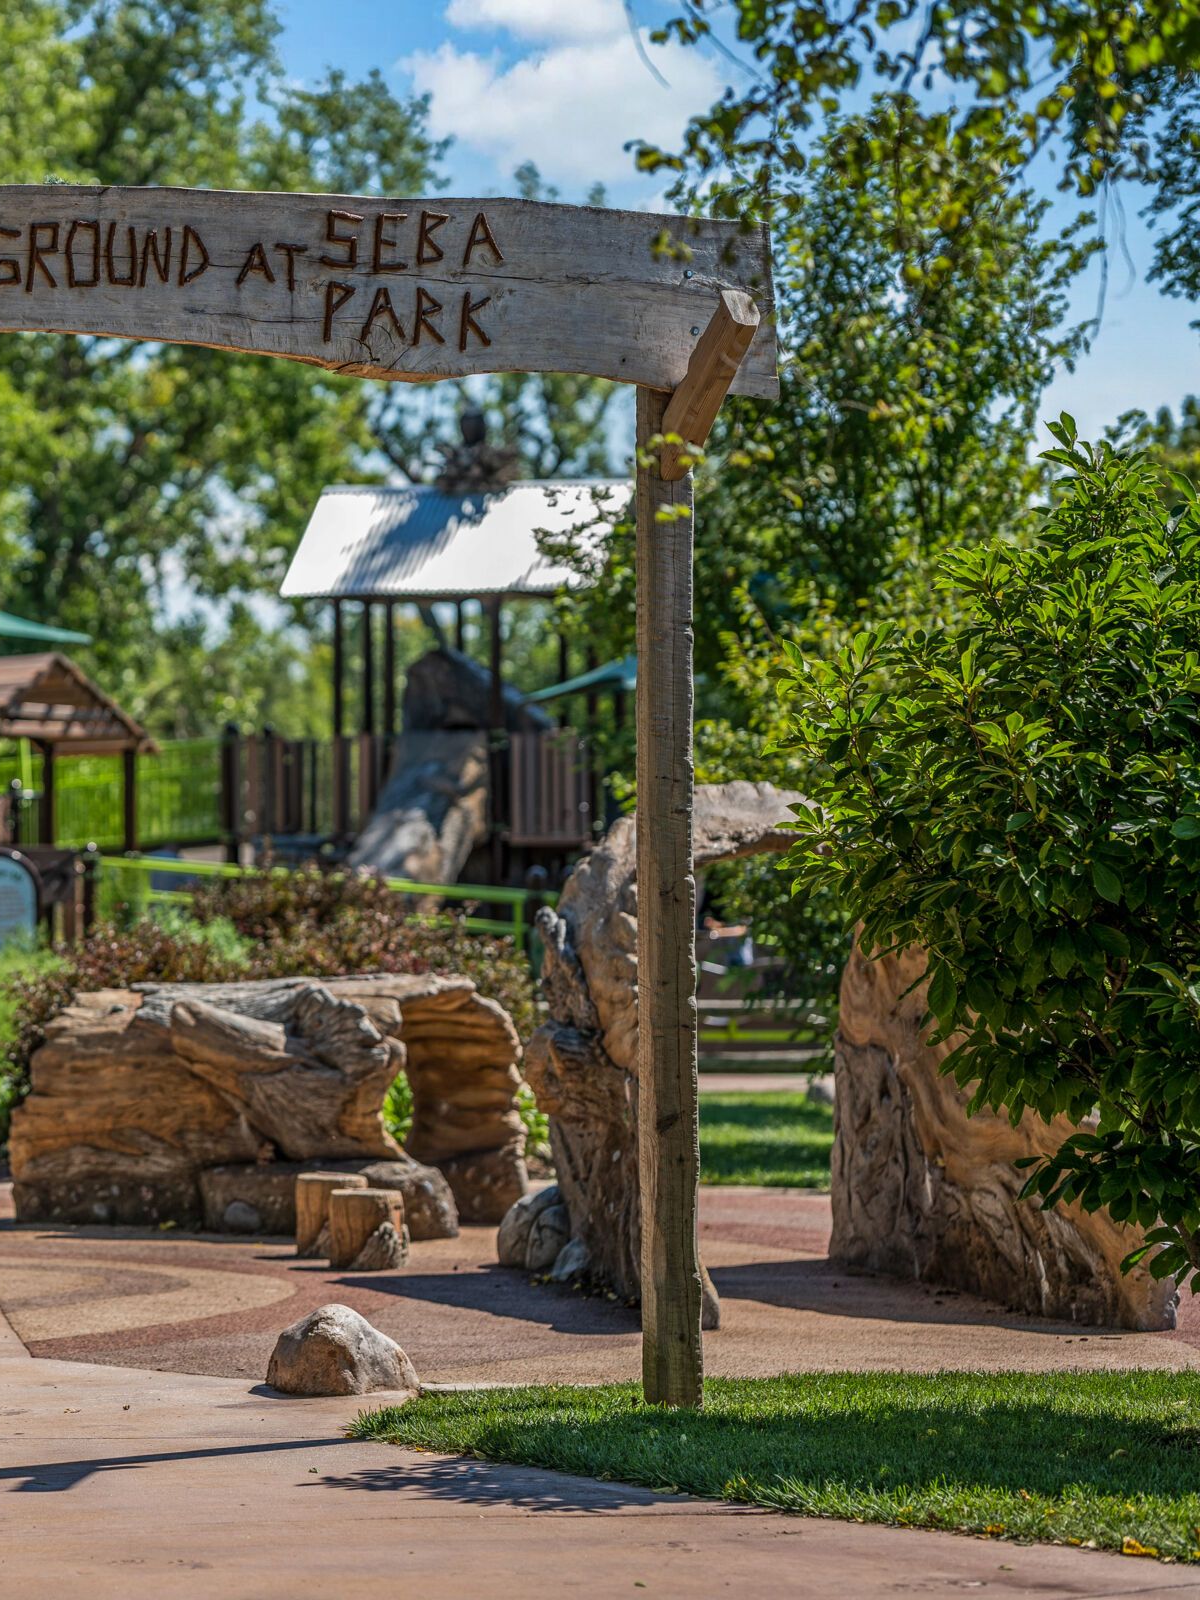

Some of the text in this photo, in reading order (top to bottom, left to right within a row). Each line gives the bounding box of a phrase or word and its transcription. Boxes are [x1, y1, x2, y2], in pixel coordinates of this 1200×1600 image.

[236, 241, 309, 292] AT
[320, 208, 505, 273] SEBA
[322, 280, 493, 353] PARK
